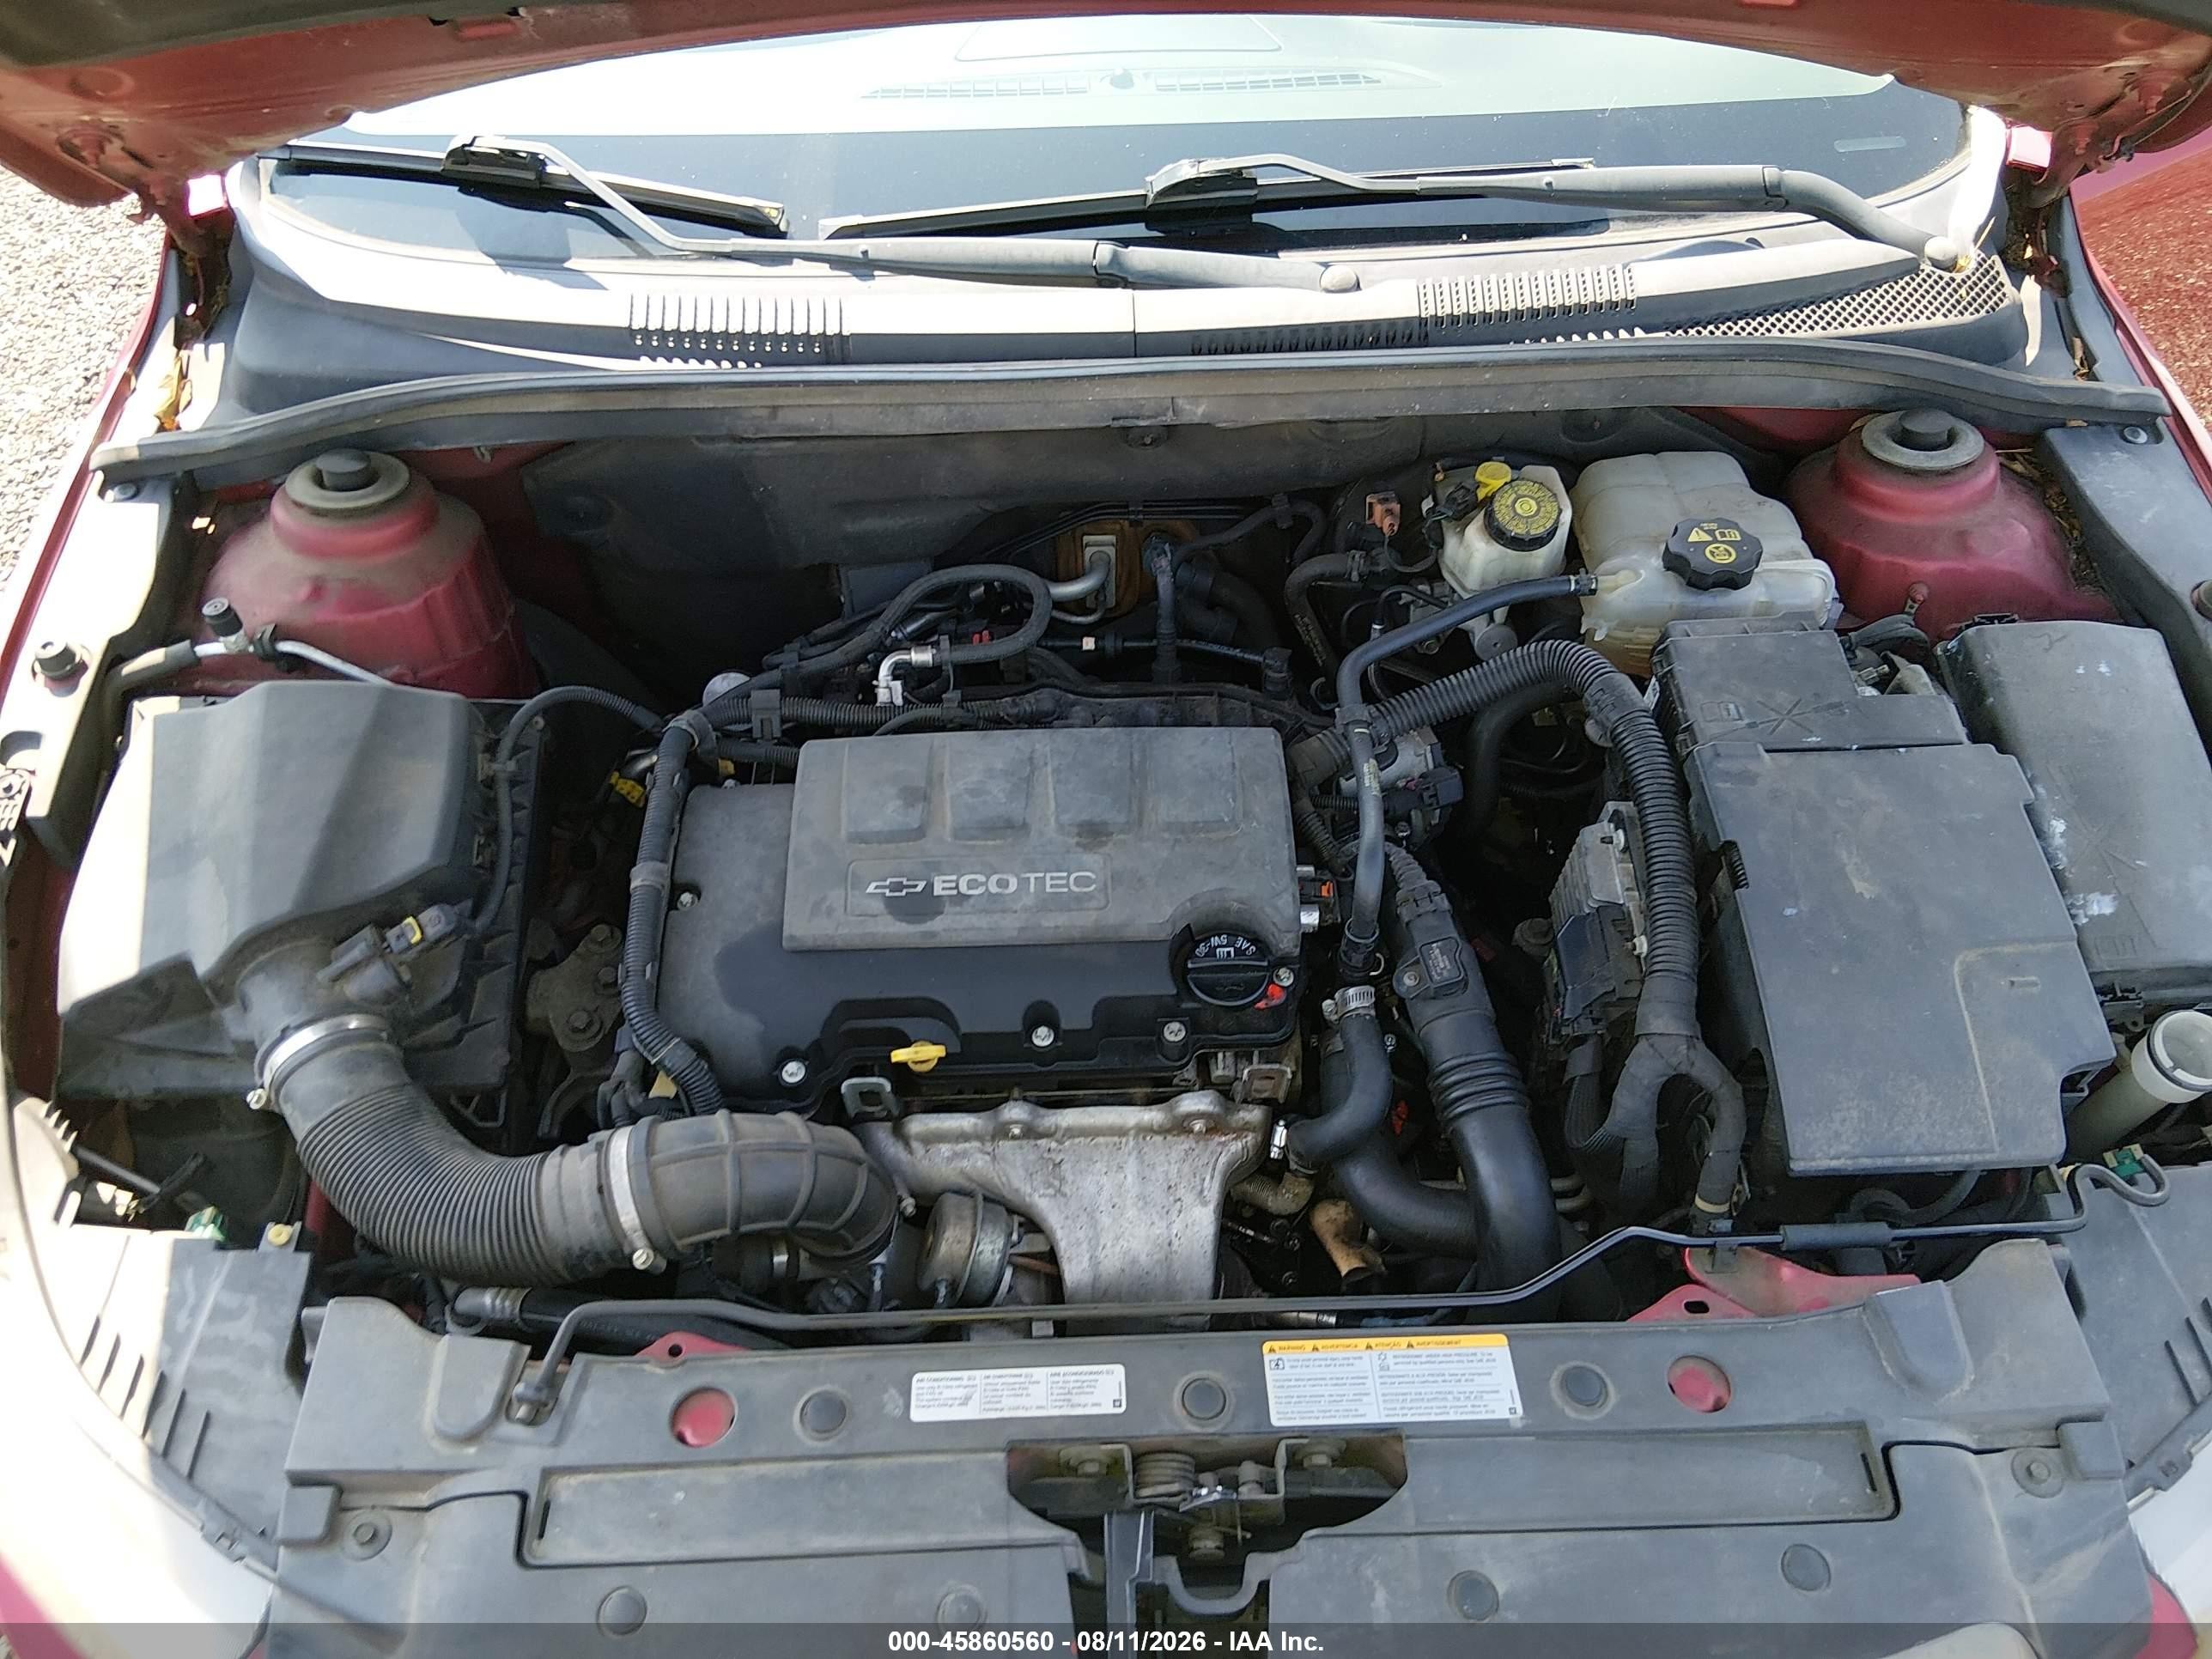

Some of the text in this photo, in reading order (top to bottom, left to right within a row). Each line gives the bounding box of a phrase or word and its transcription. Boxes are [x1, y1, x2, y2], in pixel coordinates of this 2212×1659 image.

[933, 872, 1097, 896] ECOTEC
[1195, 933, 1256, 957] SAE 5W-30
